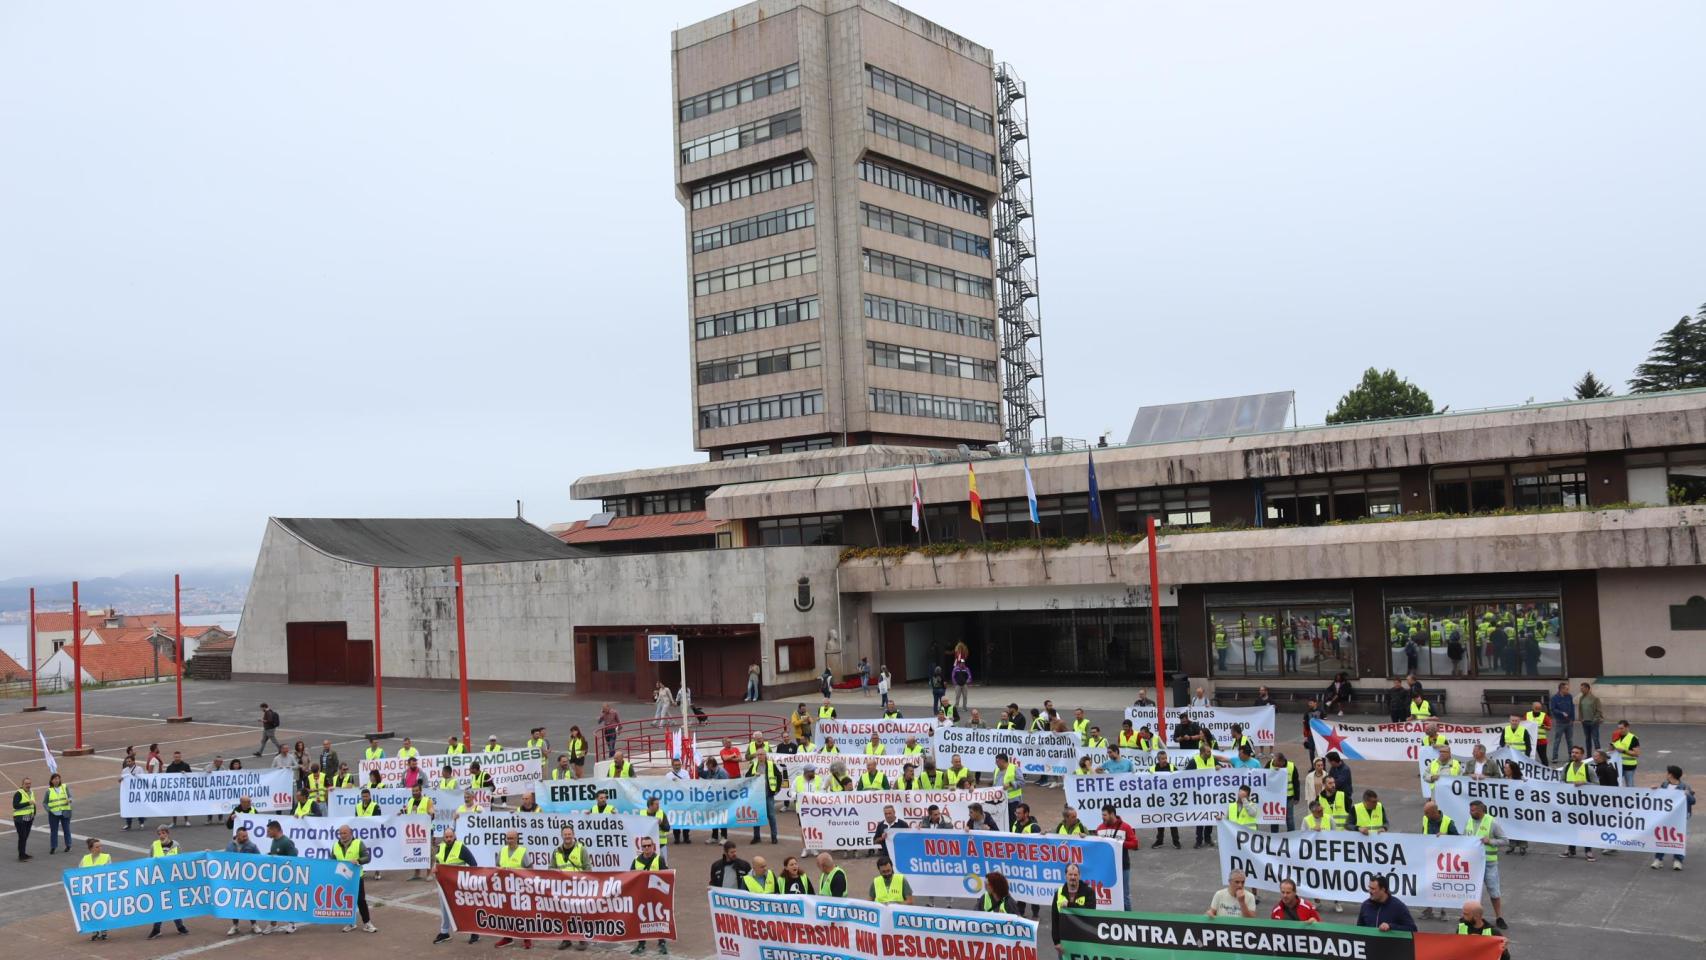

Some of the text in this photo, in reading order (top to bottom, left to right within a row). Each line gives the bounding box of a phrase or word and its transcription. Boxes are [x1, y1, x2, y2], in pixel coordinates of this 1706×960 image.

[651, 638, 660, 651] P
[820, 723, 839, 734] NON
[944, 730, 963, 742] Cos
[965, 731, 991, 743] altos
[992, 732, 1023, 744] ritmos
[1025, 733, 1036, 744] de
[1339, 723, 1364, 733] Non
[939, 743, 975, 754] cabeza
[979, 746, 984, 754] e
[1018, 748, 1034, 757] van
[1036, 749, 1046, 758] ao
[363, 761, 382, 774] NON
[384, 758, 397, 773] AO
[421, 758, 433, 769] EN
[436, 749, 541, 768] HISPAMOLDES
[129, 778, 150, 790] NON
[161, 773, 260, 790] DESREGULARIZACIÓN
[1076, 772, 1267, 793] ERTE estafa empresarial
[128, 785, 270, 803] DA XORNADA NA AUTOMOCIÓN
[551, 785, 597, 802] ERTES
[642, 786, 749, 805] copo ibérica
[801, 789, 1003, 805] A NOSA INDUSTRIA É O NOSO FUTURO
[1078, 790, 1236, 810] xornada de 32 horas
[1451, 779, 1673, 813] O ERTE e as subvencións
[801, 807, 859, 817] FORVIA
[1263, 802, 1286, 816] CIG
[1513, 806, 1545, 822] son
[1551, 810, 1561, 824] a
[1567, 809, 1645, 831] solución
[405, 823, 427, 840] CIG
[466, 815, 528, 829] Stellantis
[530, 819, 544, 829] as
[548, 816, 574, 829] túas
[577, 817, 625, 831] axudas
[463, 833, 480, 846] do
[484, 832, 524, 847] PERE
[527, 835, 549, 846] son
[552, 836, 560, 847] o
[596, 834, 629, 849] ERTE
[1654, 825, 1684, 843] CIG
[925, 838, 963, 857] NON
[982, 839, 1083, 865] REPRESIÓN
[1236, 830, 1407, 866] POLA DEFENSA
[910, 857, 1061, 880] Sindical e Laboral en
[1437, 852, 1470, 873] CIG
[70, 857, 310, 897] ERTES NA AUTOMOCIÓN
[457, 870, 622, 898] Non á destrución do
[1230, 855, 1417, 897] DA AUTOMOCIÓN
[314, 884, 354, 910] CIG
[1431, 880, 1475, 895] snop
[81, 885, 308, 923] ROUBO E EXPOTACIÓN
[455, 890, 634, 914] sector da automoción
[314, 910, 353, 918] INDUSTRIA
[637, 902, 670, 923] CIG
[714, 894, 1032, 939] INDUSTRIA FUTURO AUTOMOCIÓN
[476, 908, 626, 939] Convenios dignos
[715, 912, 1038, 960] NIN RECONVERSIÓN NIN DESLOCALIZACIÓN
[719, 936, 740, 953] CIG
[1097, 922, 1366, 959] CONTRA A PRECARIEDADE
